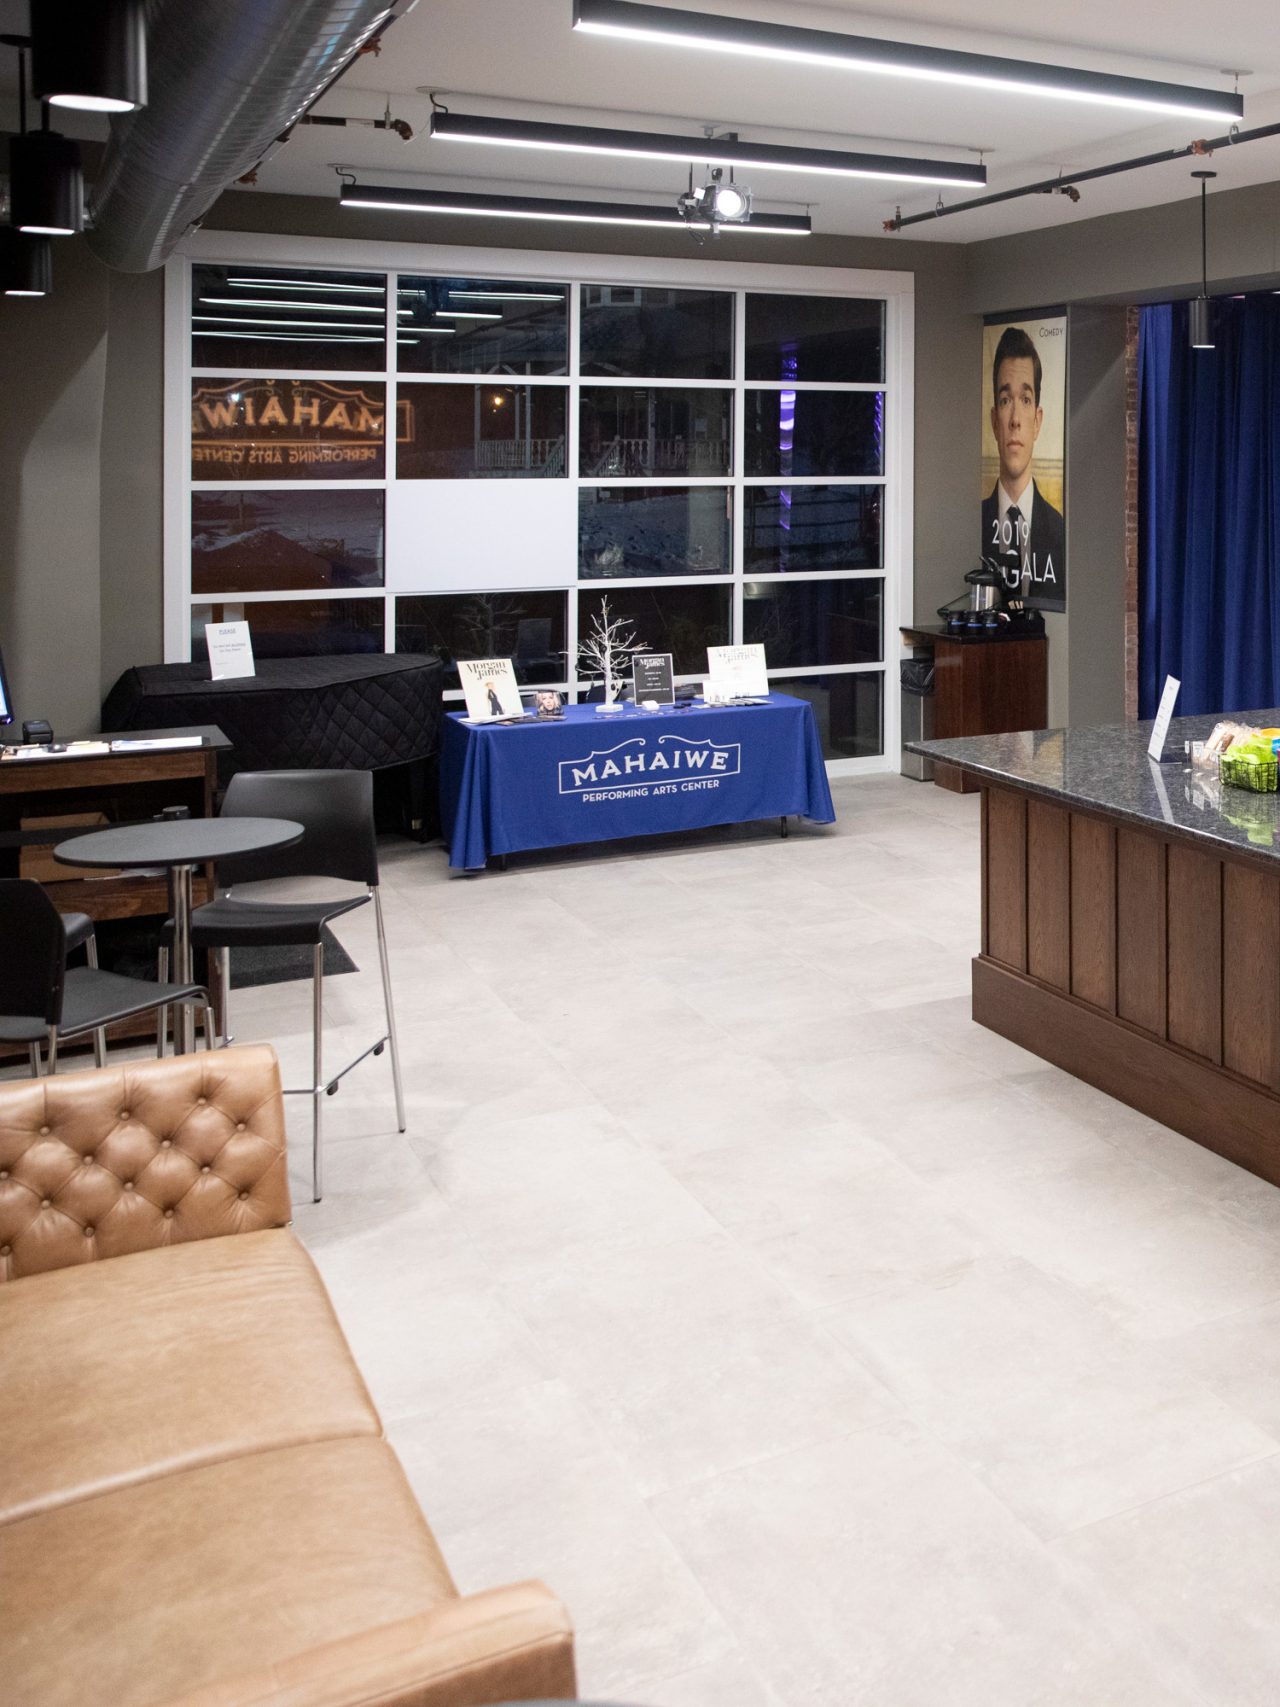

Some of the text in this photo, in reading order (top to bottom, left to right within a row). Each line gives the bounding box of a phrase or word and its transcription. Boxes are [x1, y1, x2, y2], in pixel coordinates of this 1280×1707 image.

[991, 519, 1030, 547] 2019
[1002, 549, 1057, 589] GALA
[466, 660, 507, 674] Morgan
[477, 668, 508, 681] James
[571, 750, 729, 787] MAHAIWE
[582, 779, 720, 803] PERFORMING ARTS CENTER
